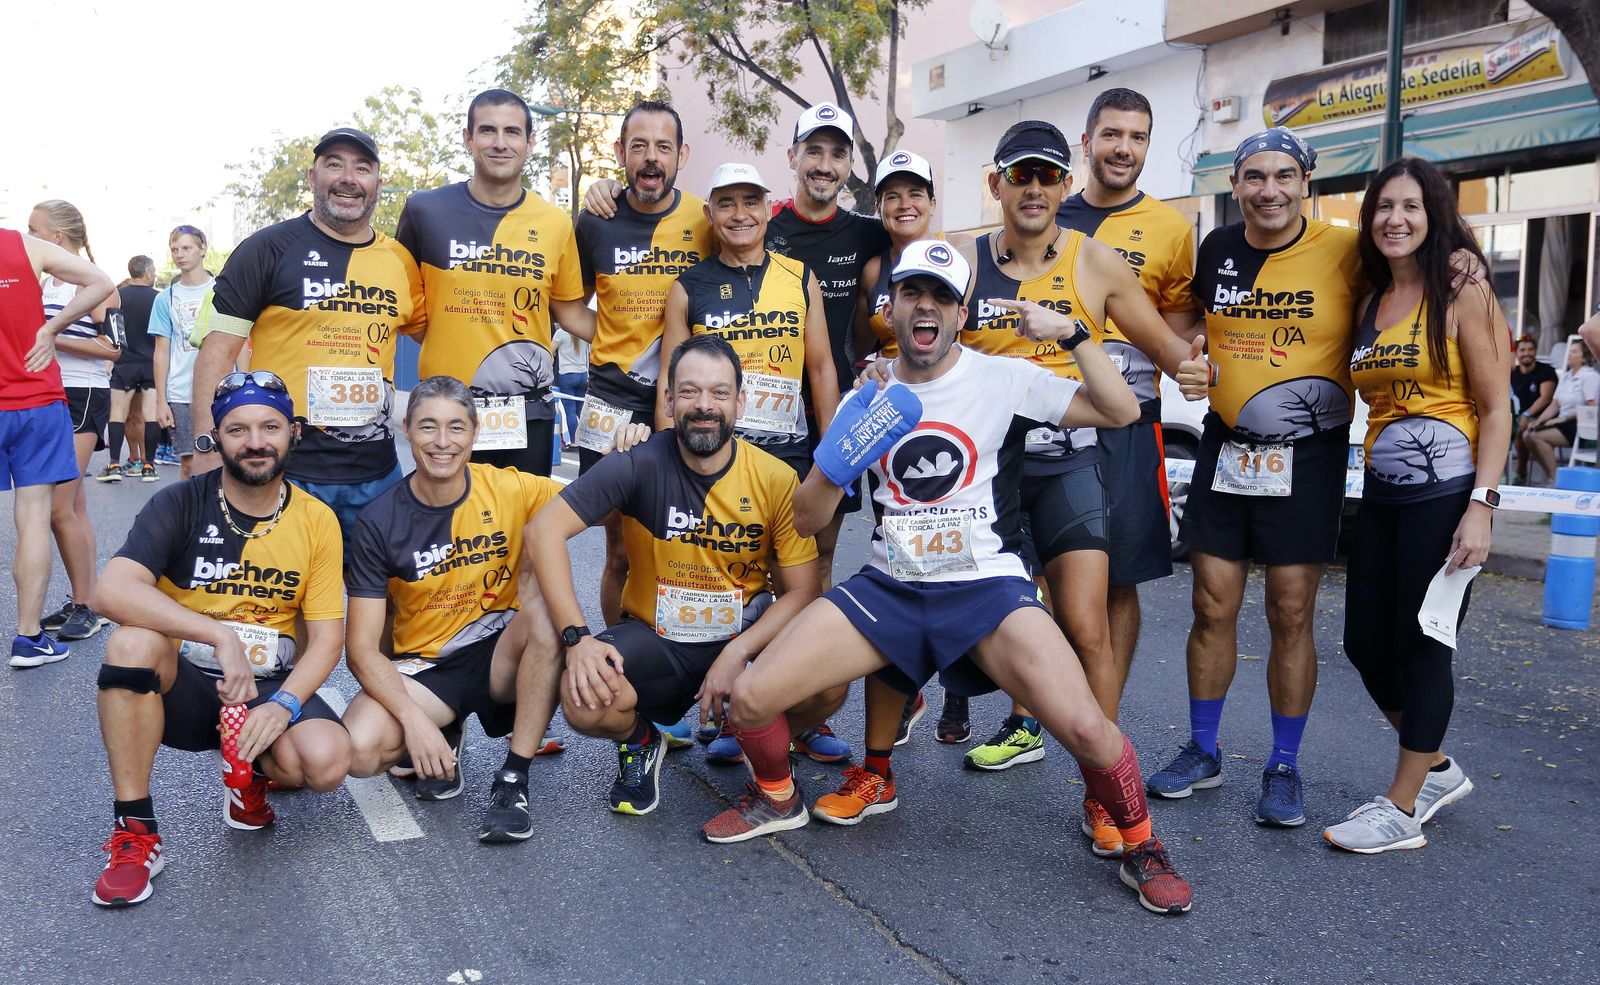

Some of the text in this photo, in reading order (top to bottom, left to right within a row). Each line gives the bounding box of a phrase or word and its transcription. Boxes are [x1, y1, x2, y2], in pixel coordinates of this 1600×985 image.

[1318, 89, 1334, 107] La
[1420, 59, 1481, 87] Sedella
[449, 239, 546, 268] bichos
[614, 246, 700, 264] bichos
[449, 260, 544, 281] runners
[1217, 268, 1239, 277] VIATOR
[303, 277, 399, 305] bichos
[453, 287, 507, 299] Colegio Oficial
[619, 289, 644, 299] Colegio
[1214, 283, 1315, 307] bichos
[303, 299, 399, 318] runners
[444, 305, 505, 317] Administrativos
[461, 297, 506, 308] de Gestores
[469, 315, 479, 324] de
[705, 310, 800, 331] bichos
[1212, 304, 1314, 320] runners
[317, 325, 362, 335] Colegio Oficial
[333, 334, 362, 342] Gestores
[1224, 330, 1245, 339] Colegio
[306, 339, 362, 349] Administrativos
[330, 383, 379, 404] 388
[756, 381, 778, 389] TORCAL
[754, 390, 794, 413] 777
[479, 411, 519, 430] 06
[667, 506, 764, 539] bichos
[908, 524, 934, 532] TORCAL
[199, 536, 224, 545] VIATOR
[908, 530, 963, 557] 143
[413, 530, 508, 569] bichos
[193, 556, 301, 587] bichos
[417, 545, 509, 581] runners
[668, 559, 699, 571] Colegio
[655, 575, 727, 591] Administrativos
[675, 571, 687, 579] de
[190, 579, 297, 601] runners
[679, 605, 736, 625] 613
[244, 628, 268, 636] URBANA
